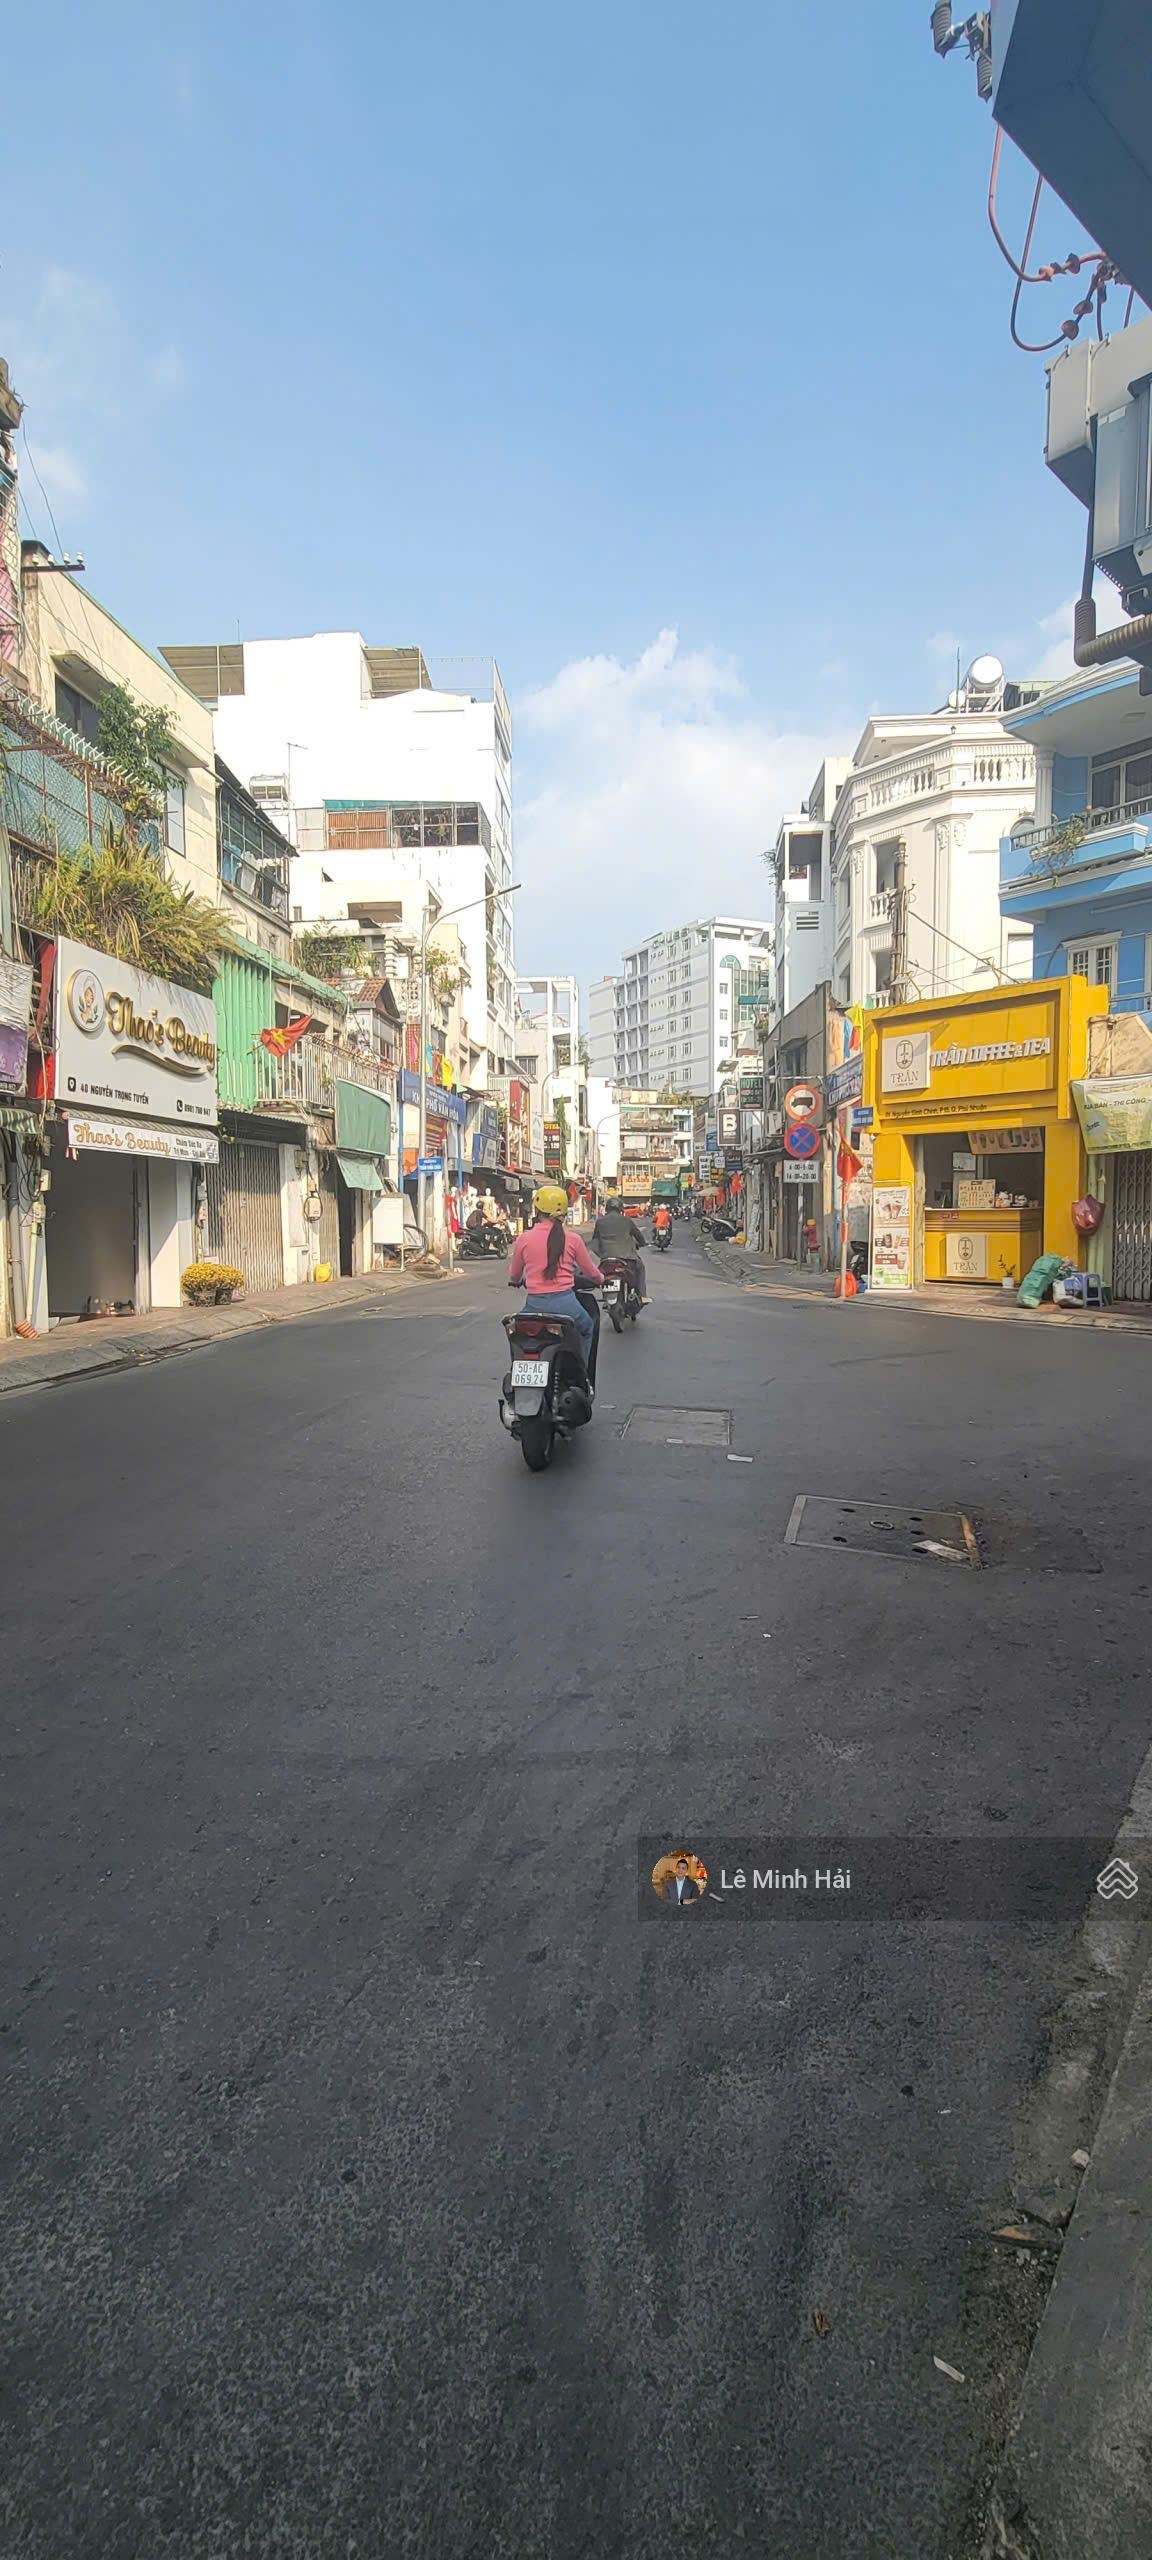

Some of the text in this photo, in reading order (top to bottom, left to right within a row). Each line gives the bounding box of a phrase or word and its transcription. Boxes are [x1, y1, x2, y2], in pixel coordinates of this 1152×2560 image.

[165, 1016, 215, 1071] Beauty
[967, 1041, 1014, 1063] COFFEE
[1024, 1037, 1050, 1057] TEA
[741, 1078, 763, 1089] HOTEL
[723, 1113, 737, 1131] B
[125, 1132, 171, 1156] Beauty
